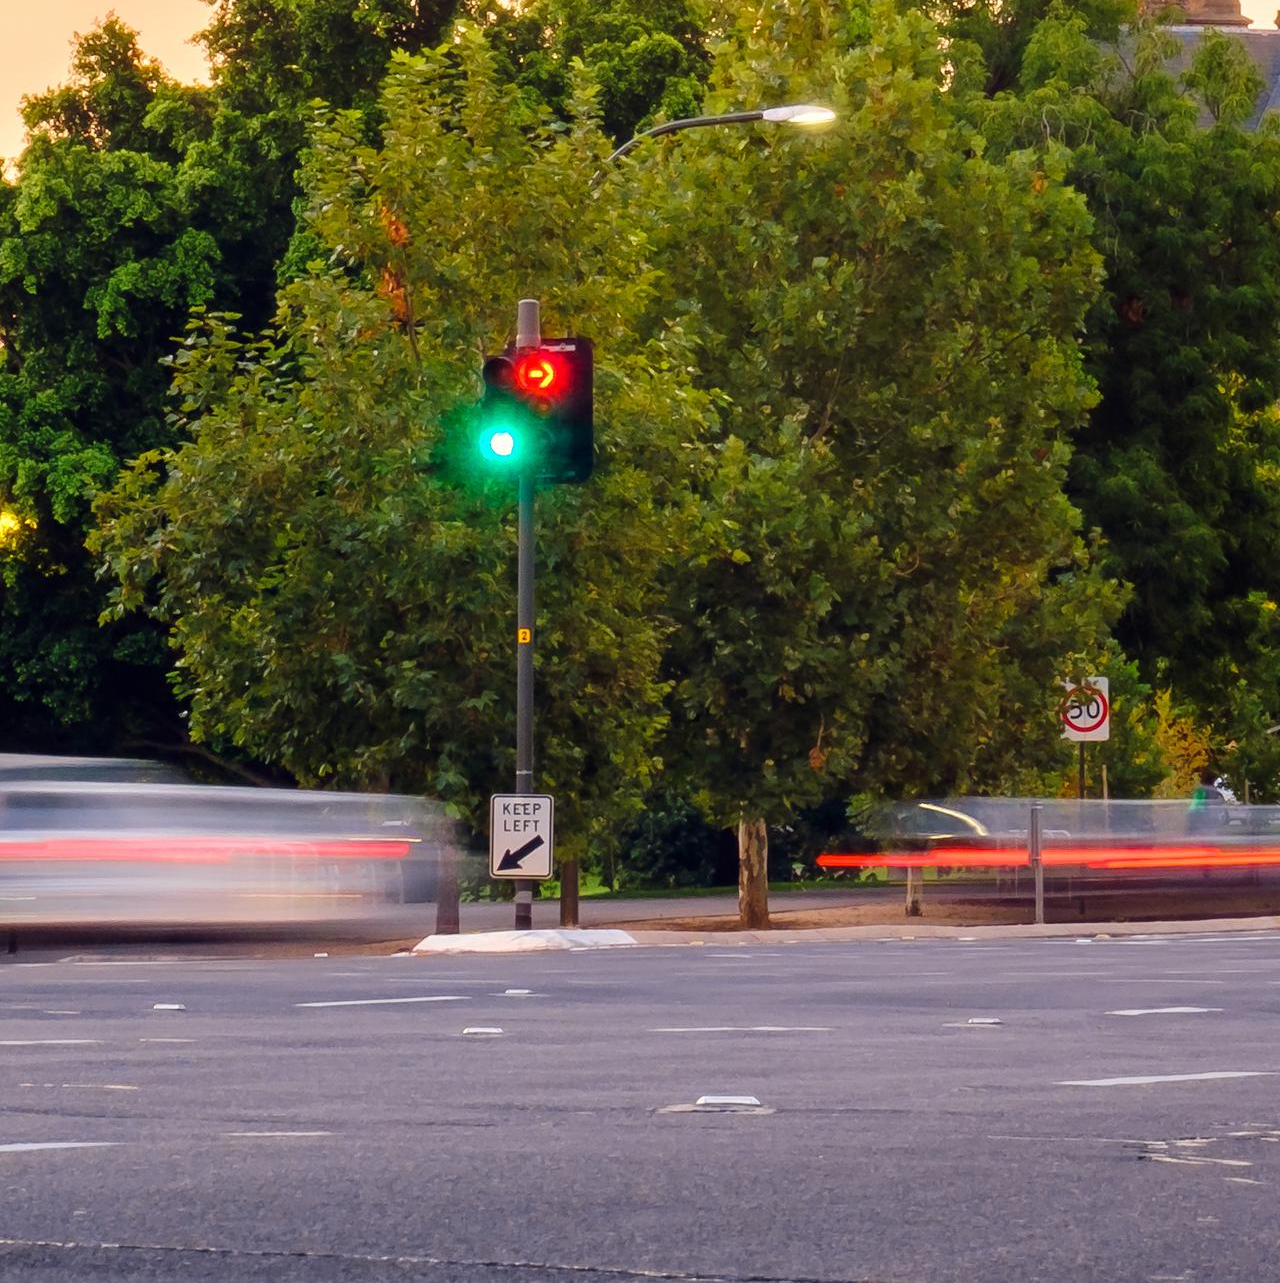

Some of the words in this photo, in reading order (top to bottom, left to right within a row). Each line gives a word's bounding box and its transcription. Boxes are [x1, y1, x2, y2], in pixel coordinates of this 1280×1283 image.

[1070, 698, 1100, 719] 50
[503, 803, 541, 815] KEEP
[504, 820, 540, 832] LEFT
